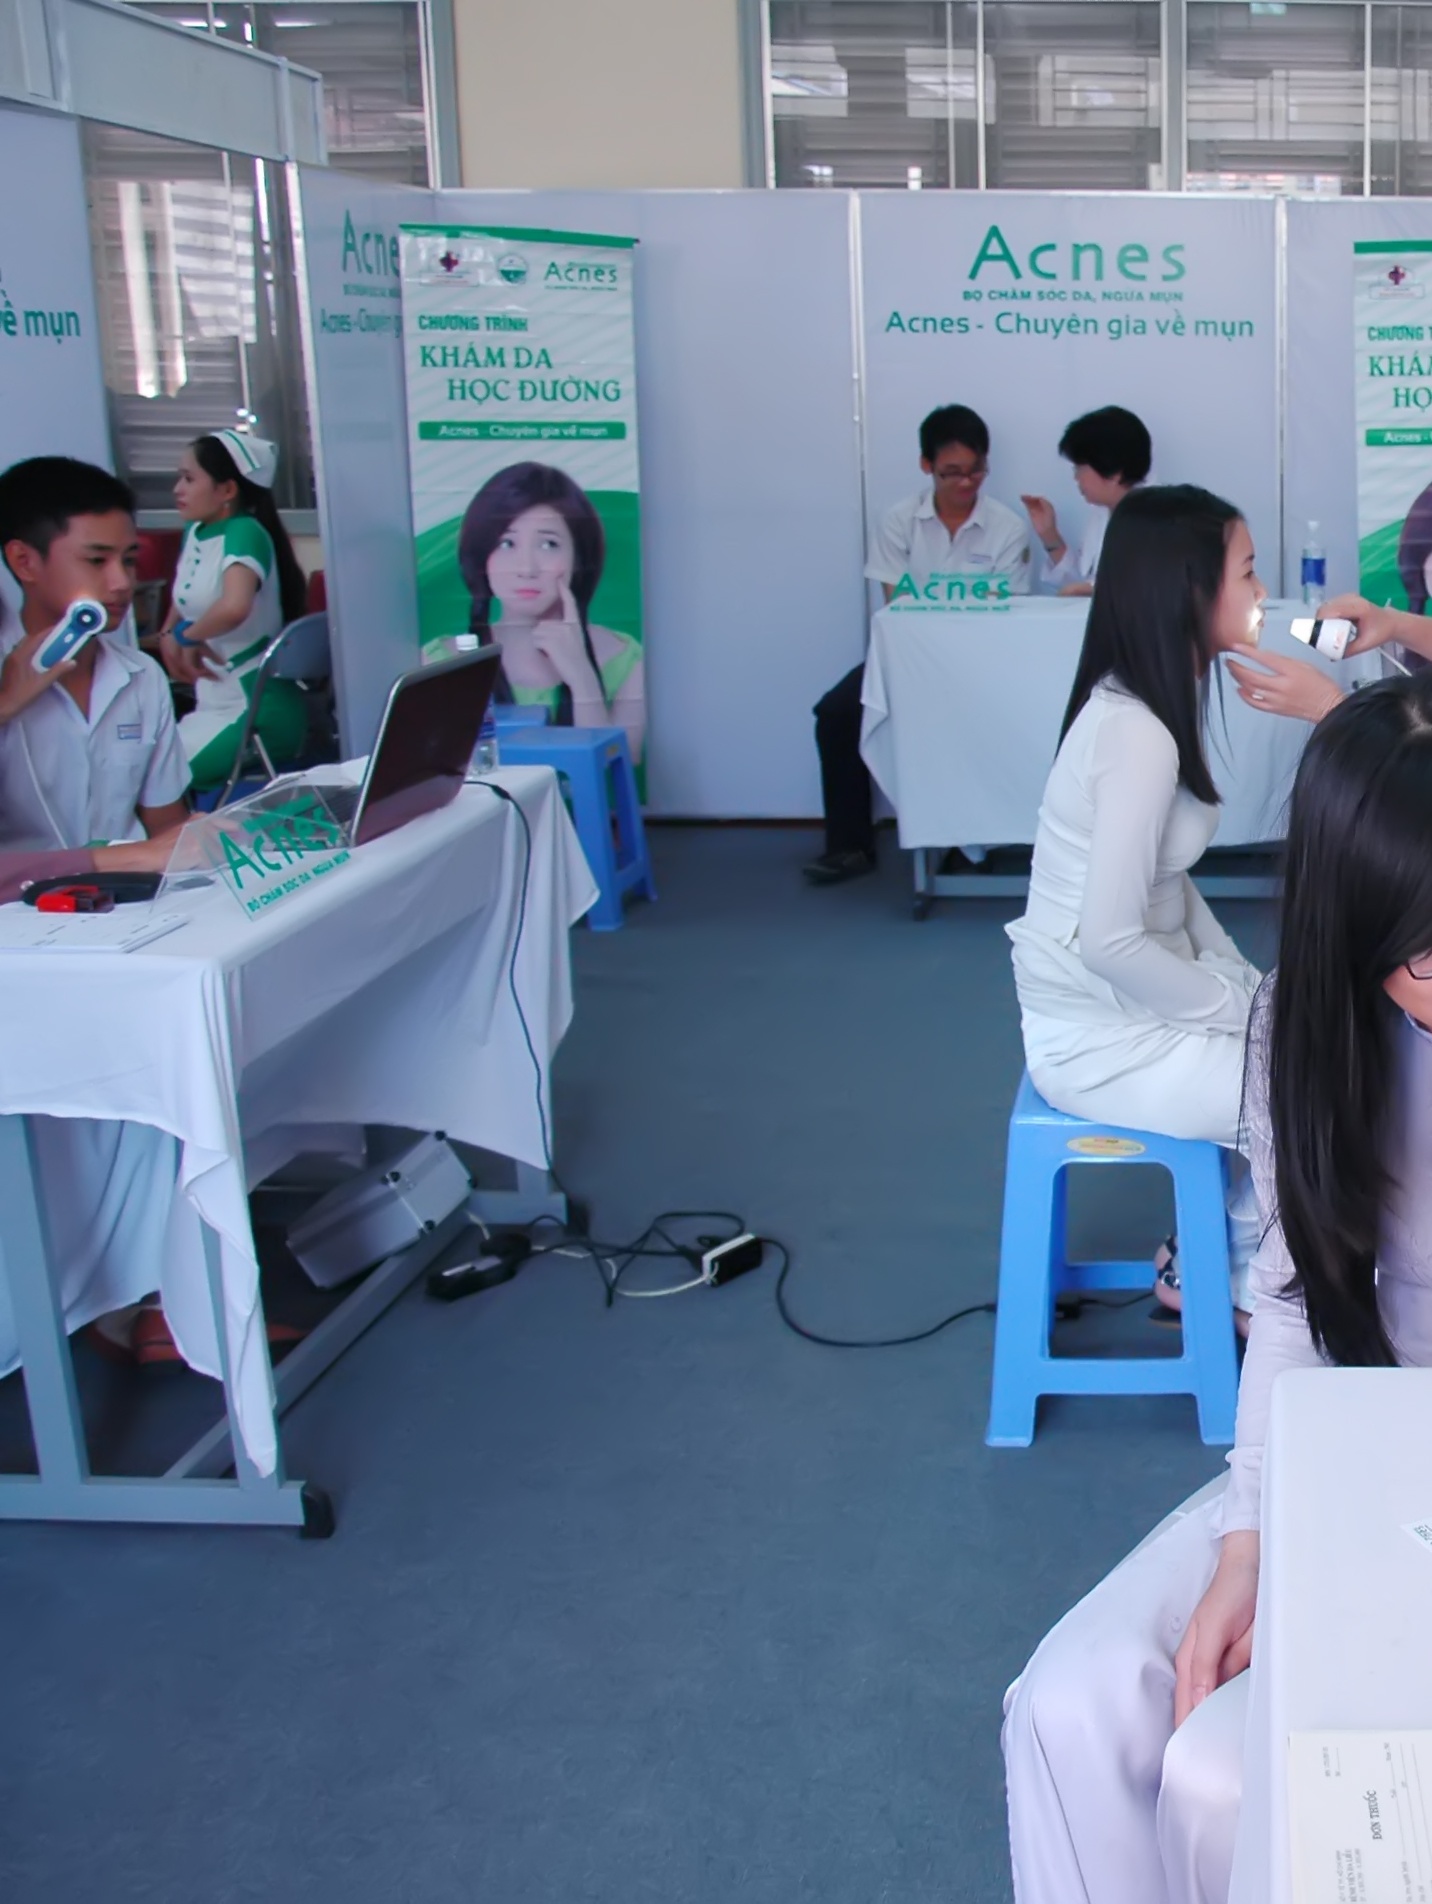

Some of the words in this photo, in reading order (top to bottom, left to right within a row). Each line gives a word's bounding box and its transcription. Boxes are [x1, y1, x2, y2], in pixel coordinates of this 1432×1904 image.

[342, 208, 400, 278] Acne
[968, 224, 1187, 282] Acnes
[544, 261, 618, 284] Acnes
[23, 310, 81, 344] mụn
[418, 314, 480, 331] CHƯƠNG
[485, 314, 528, 332] TRÌNH
[885, 311, 970, 335] Acnes
[994, 311, 1098, 340] Chuyên
[1107, 312, 1147, 340] gia
[1155, 308, 1186, 337] về
[1195, 319, 1254, 342] mụn
[1367, 324, 1424, 341] CHƯƠNG
[420, 342, 505, 369] KHÁM
[513, 347, 553, 369] DA
[448, 378, 510, 406] HỌC
[518, 374, 622, 402] ĐƯỜNG
[892, 572, 1012, 601] Acnes
[218, 805, 339, 890] Acnes
[1363, 1789, 1380, 1819] THUỐC
[1370, 1822, 1383, 1840] ĐƠN
